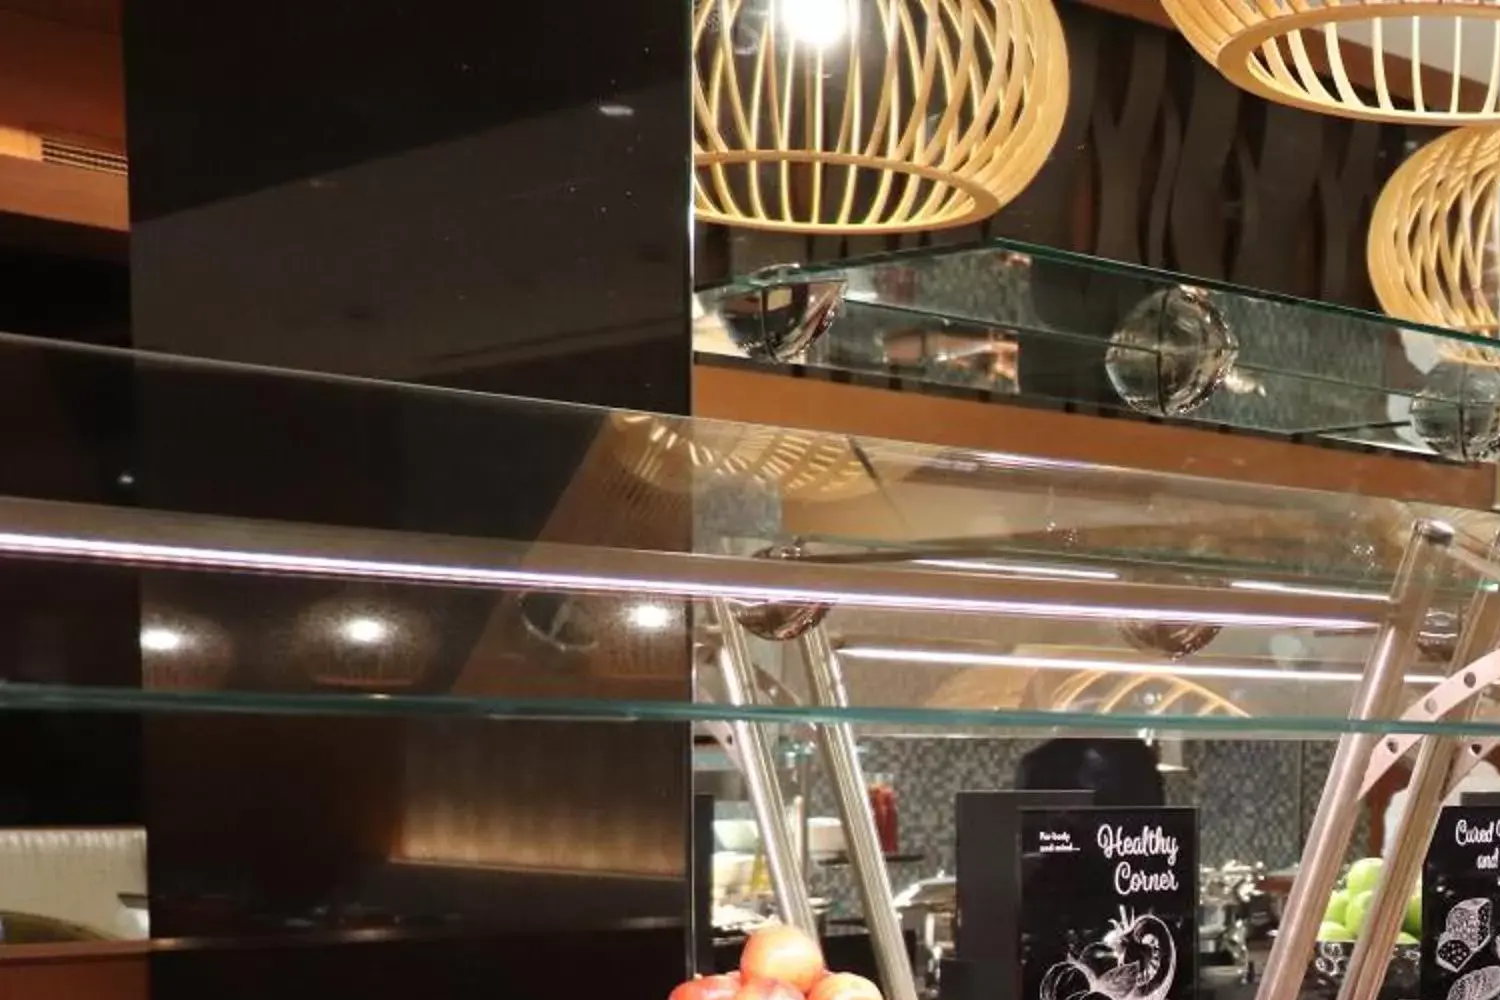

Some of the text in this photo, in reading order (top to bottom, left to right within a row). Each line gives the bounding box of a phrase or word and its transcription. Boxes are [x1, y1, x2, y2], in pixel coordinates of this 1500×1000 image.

[1097, 823, 1179, 866] Healthy
[1455, 819, 1495, 846] Cured
[1477, 847, 1499, 869] and
[1114, 861, 1179, 895] Corner
